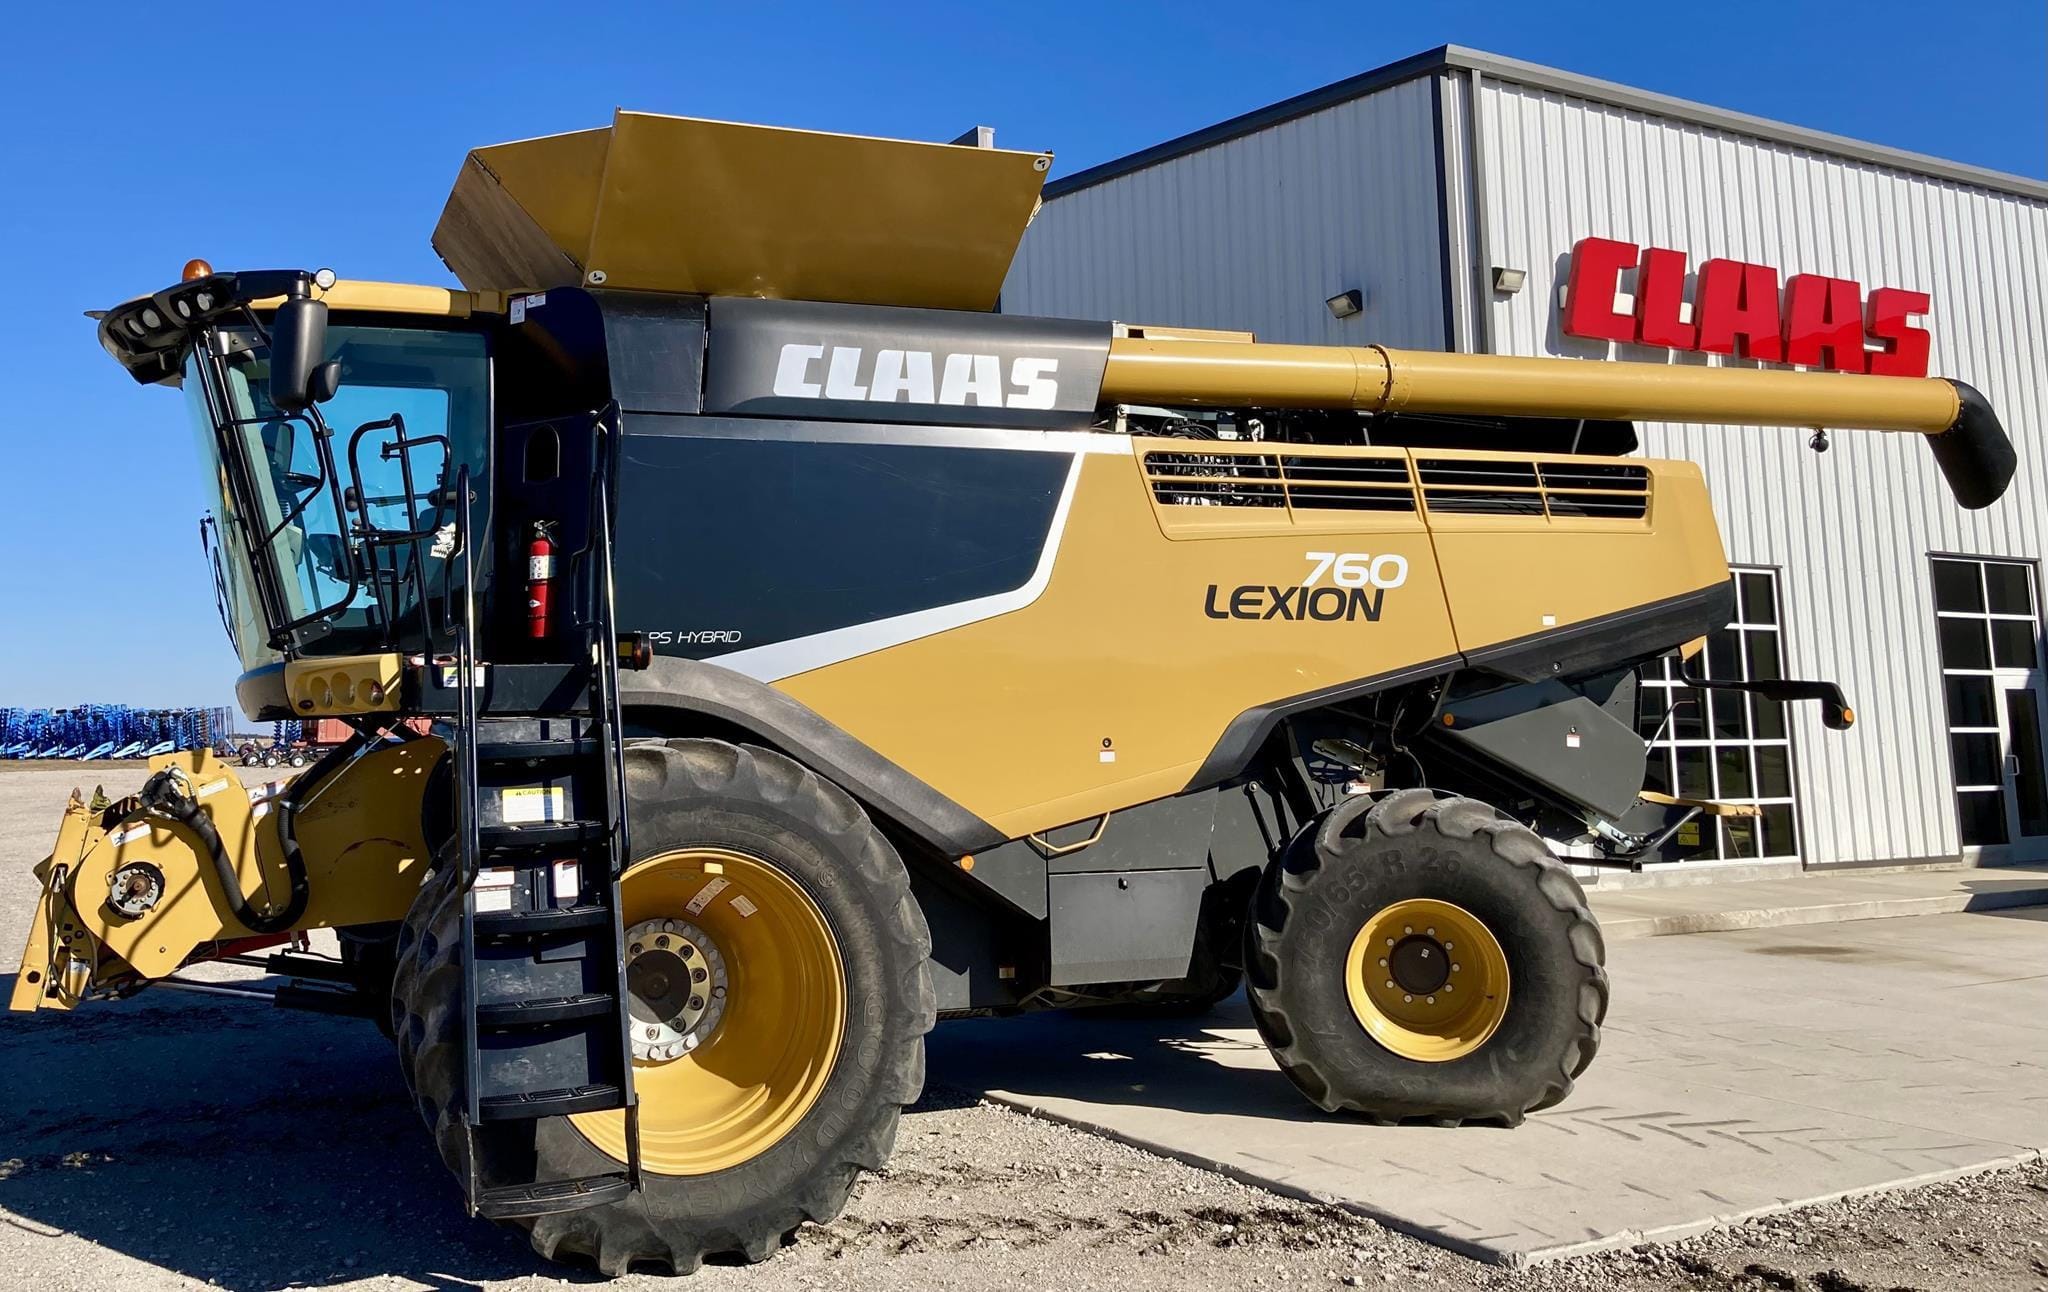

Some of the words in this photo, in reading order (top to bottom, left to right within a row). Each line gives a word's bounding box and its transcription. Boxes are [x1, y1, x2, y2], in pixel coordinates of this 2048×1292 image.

[1564, 237, 1931, 378] CLAAS
[773, 344, 1058, 410] CLAAS
[1302, 552, 1408, 588] 760
[1204, 585, 1384, 621] LEXION
[634, 630, 672, 644] PS
[678, 631, 742, 643] HYBRID
